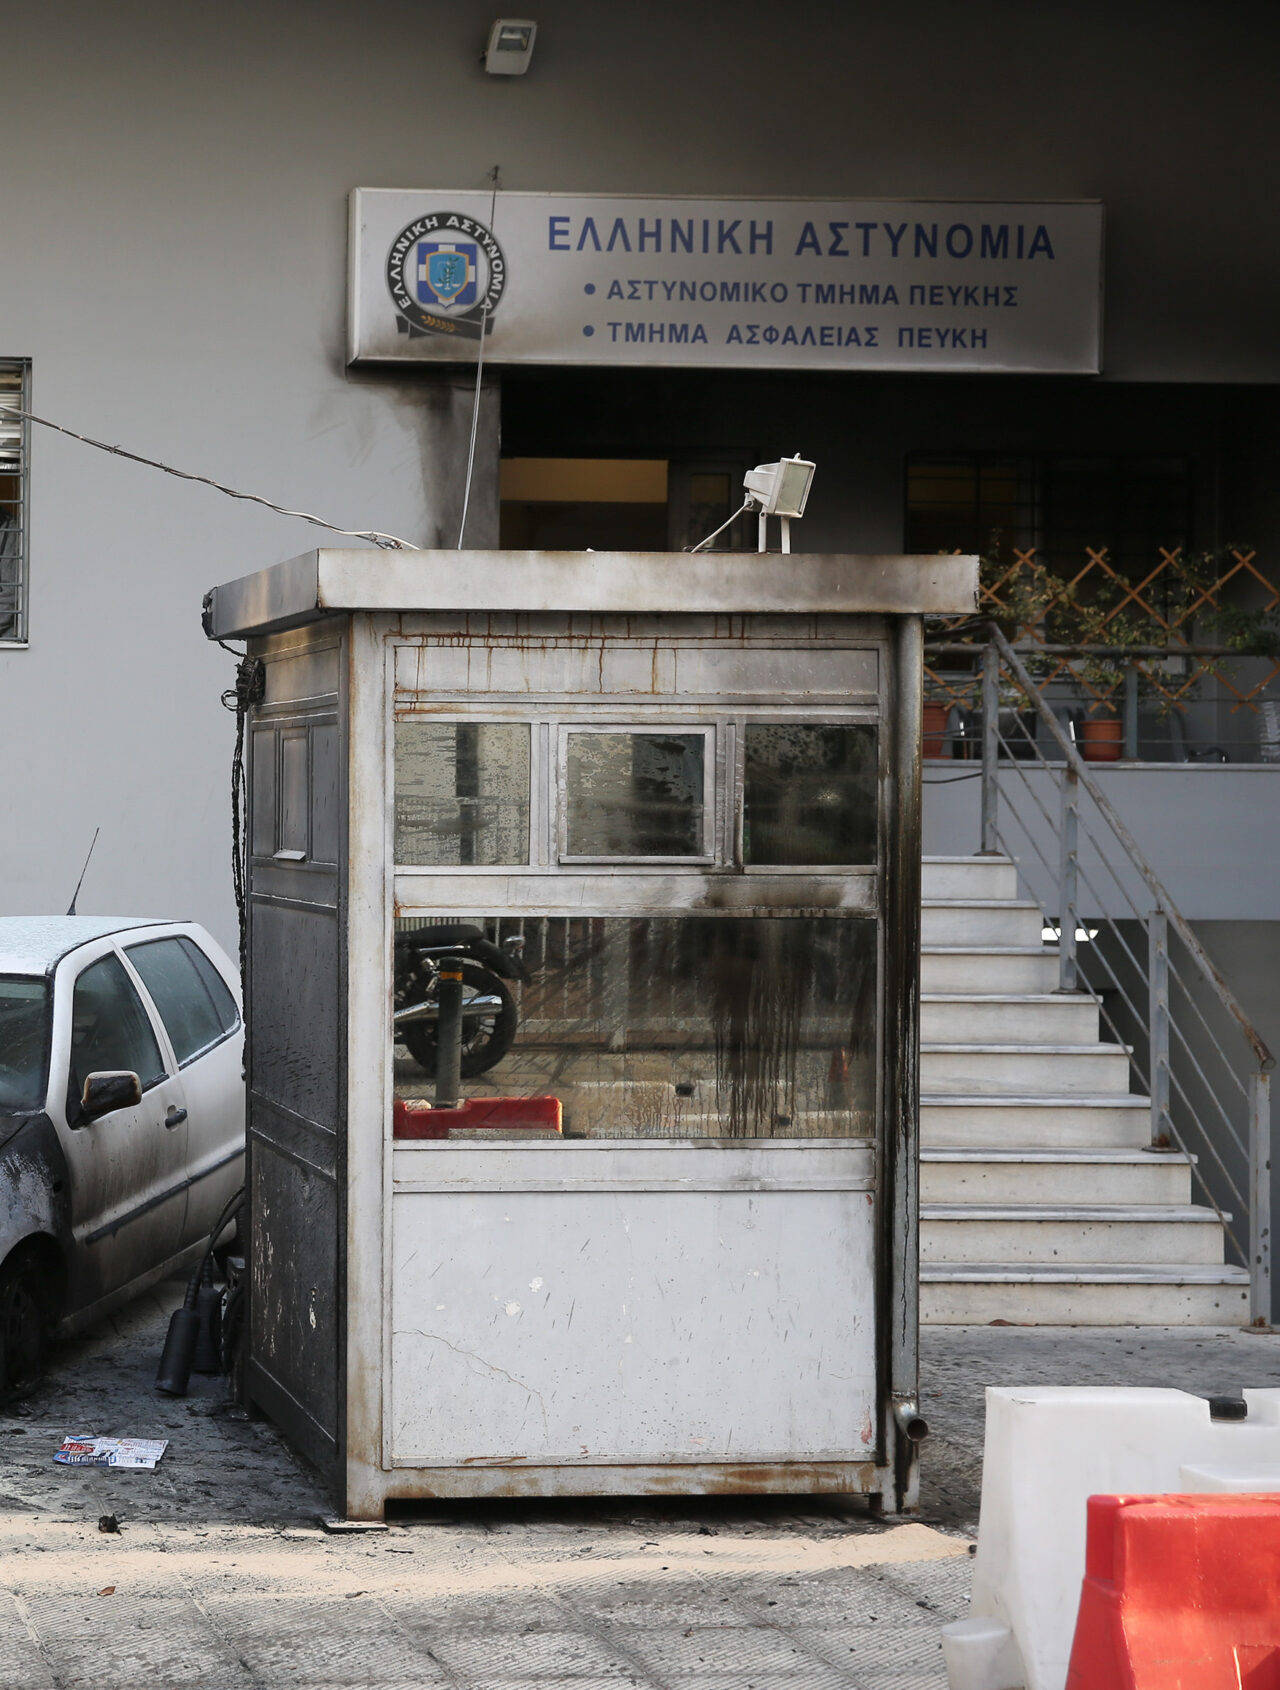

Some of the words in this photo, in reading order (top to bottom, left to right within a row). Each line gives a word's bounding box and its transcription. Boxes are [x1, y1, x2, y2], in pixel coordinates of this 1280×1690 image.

[549, 216, 773, 255] ΕΛΛΗΝΙΚΗ
[795, 221, 1055, 260] ΑΣΤΥΝΟΜΙΑ
[390, 216, 438, 309] ΕΛΛΗΝΙΚΗ
[445, 215, 504, 310] ΑΣΤΥΝΟΜΙΑ
[606, 279, 788, 304] ΑΣΤΥΝΟΜΙΚΟ
[796, 282, 900, 306] ΤΜΗΜΑ
[908, 284, 1019, 308] ΠΕΥΚΗΣ
[606, 322, 709, 345] ΤΜΗΜΑ
[725, 324, 879, 347] ΑΣΦΑΛΕΙΑΣ
[897, 327, 987, 349] ΠΕΥΚΗ
